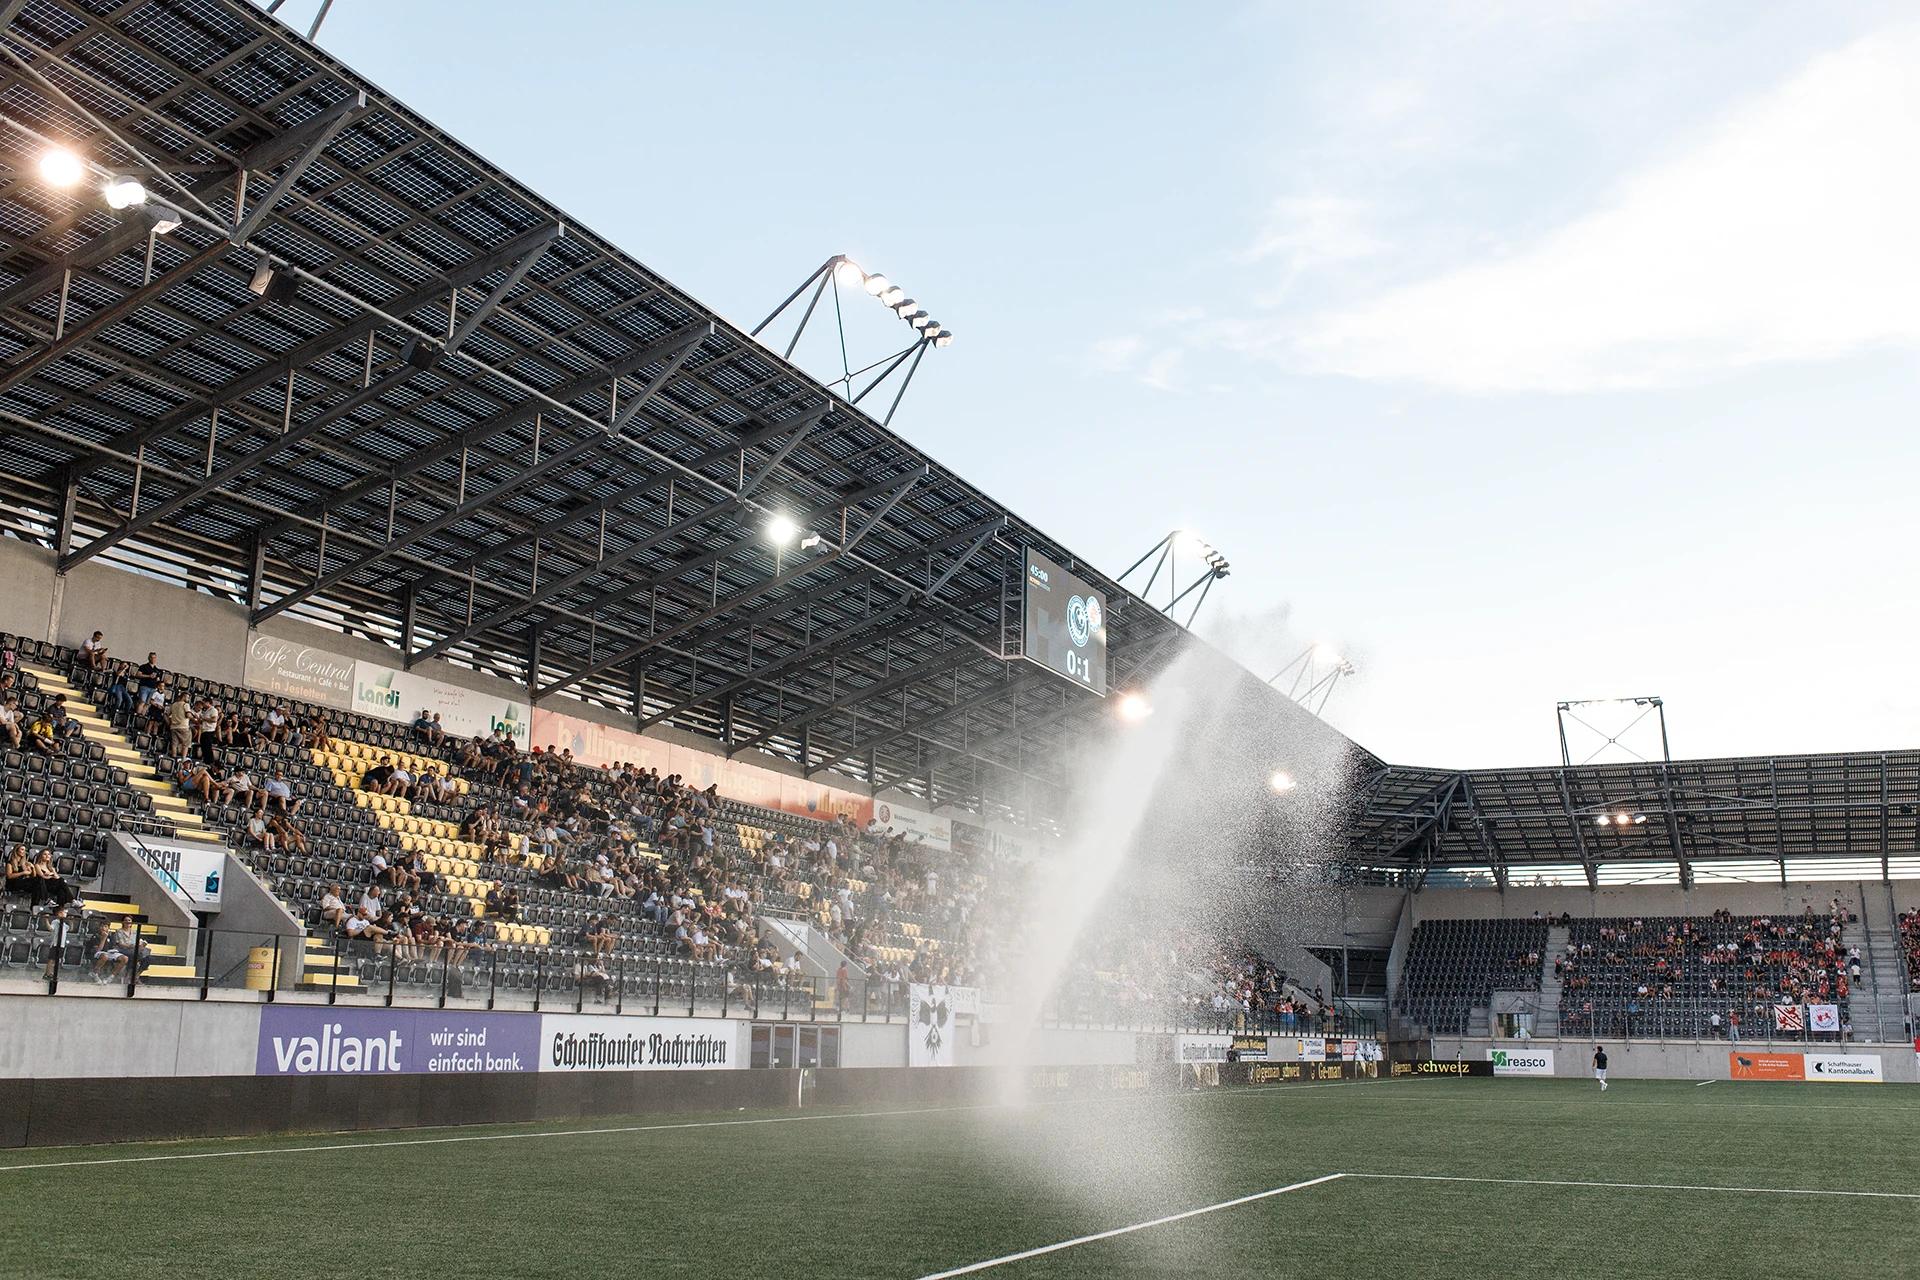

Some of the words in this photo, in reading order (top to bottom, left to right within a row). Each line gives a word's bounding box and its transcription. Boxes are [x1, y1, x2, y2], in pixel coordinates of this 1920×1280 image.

[1030, 564, 1049, 583] 45:00
[251, 636, 291, 671] Café
[294, 648, 355, 681] Central
[1066, 649, 1091, 683] 0:1
[271, 678, 281, 691] in
[277, 667, 311, 682] Restaurant
[318, 677, 332, 688] Café
[338, 682, 350, 691] Bar
[132, 847, 182, 873] RISCH
[273, 1023, 402, 1073] valiant
[430, 1030, 454, 1046] wir
[457, 1028, 487, 1046] sind
[428, 1051, 482, 1072] einfach
[485, 1051, 524, 1071] bank.
[648, 1033, 727, 1068] Nachrichten
[1508, 1058, 1546, 1068] reasco
[1828, 1067, 1875, 1075] Kantonalbank
